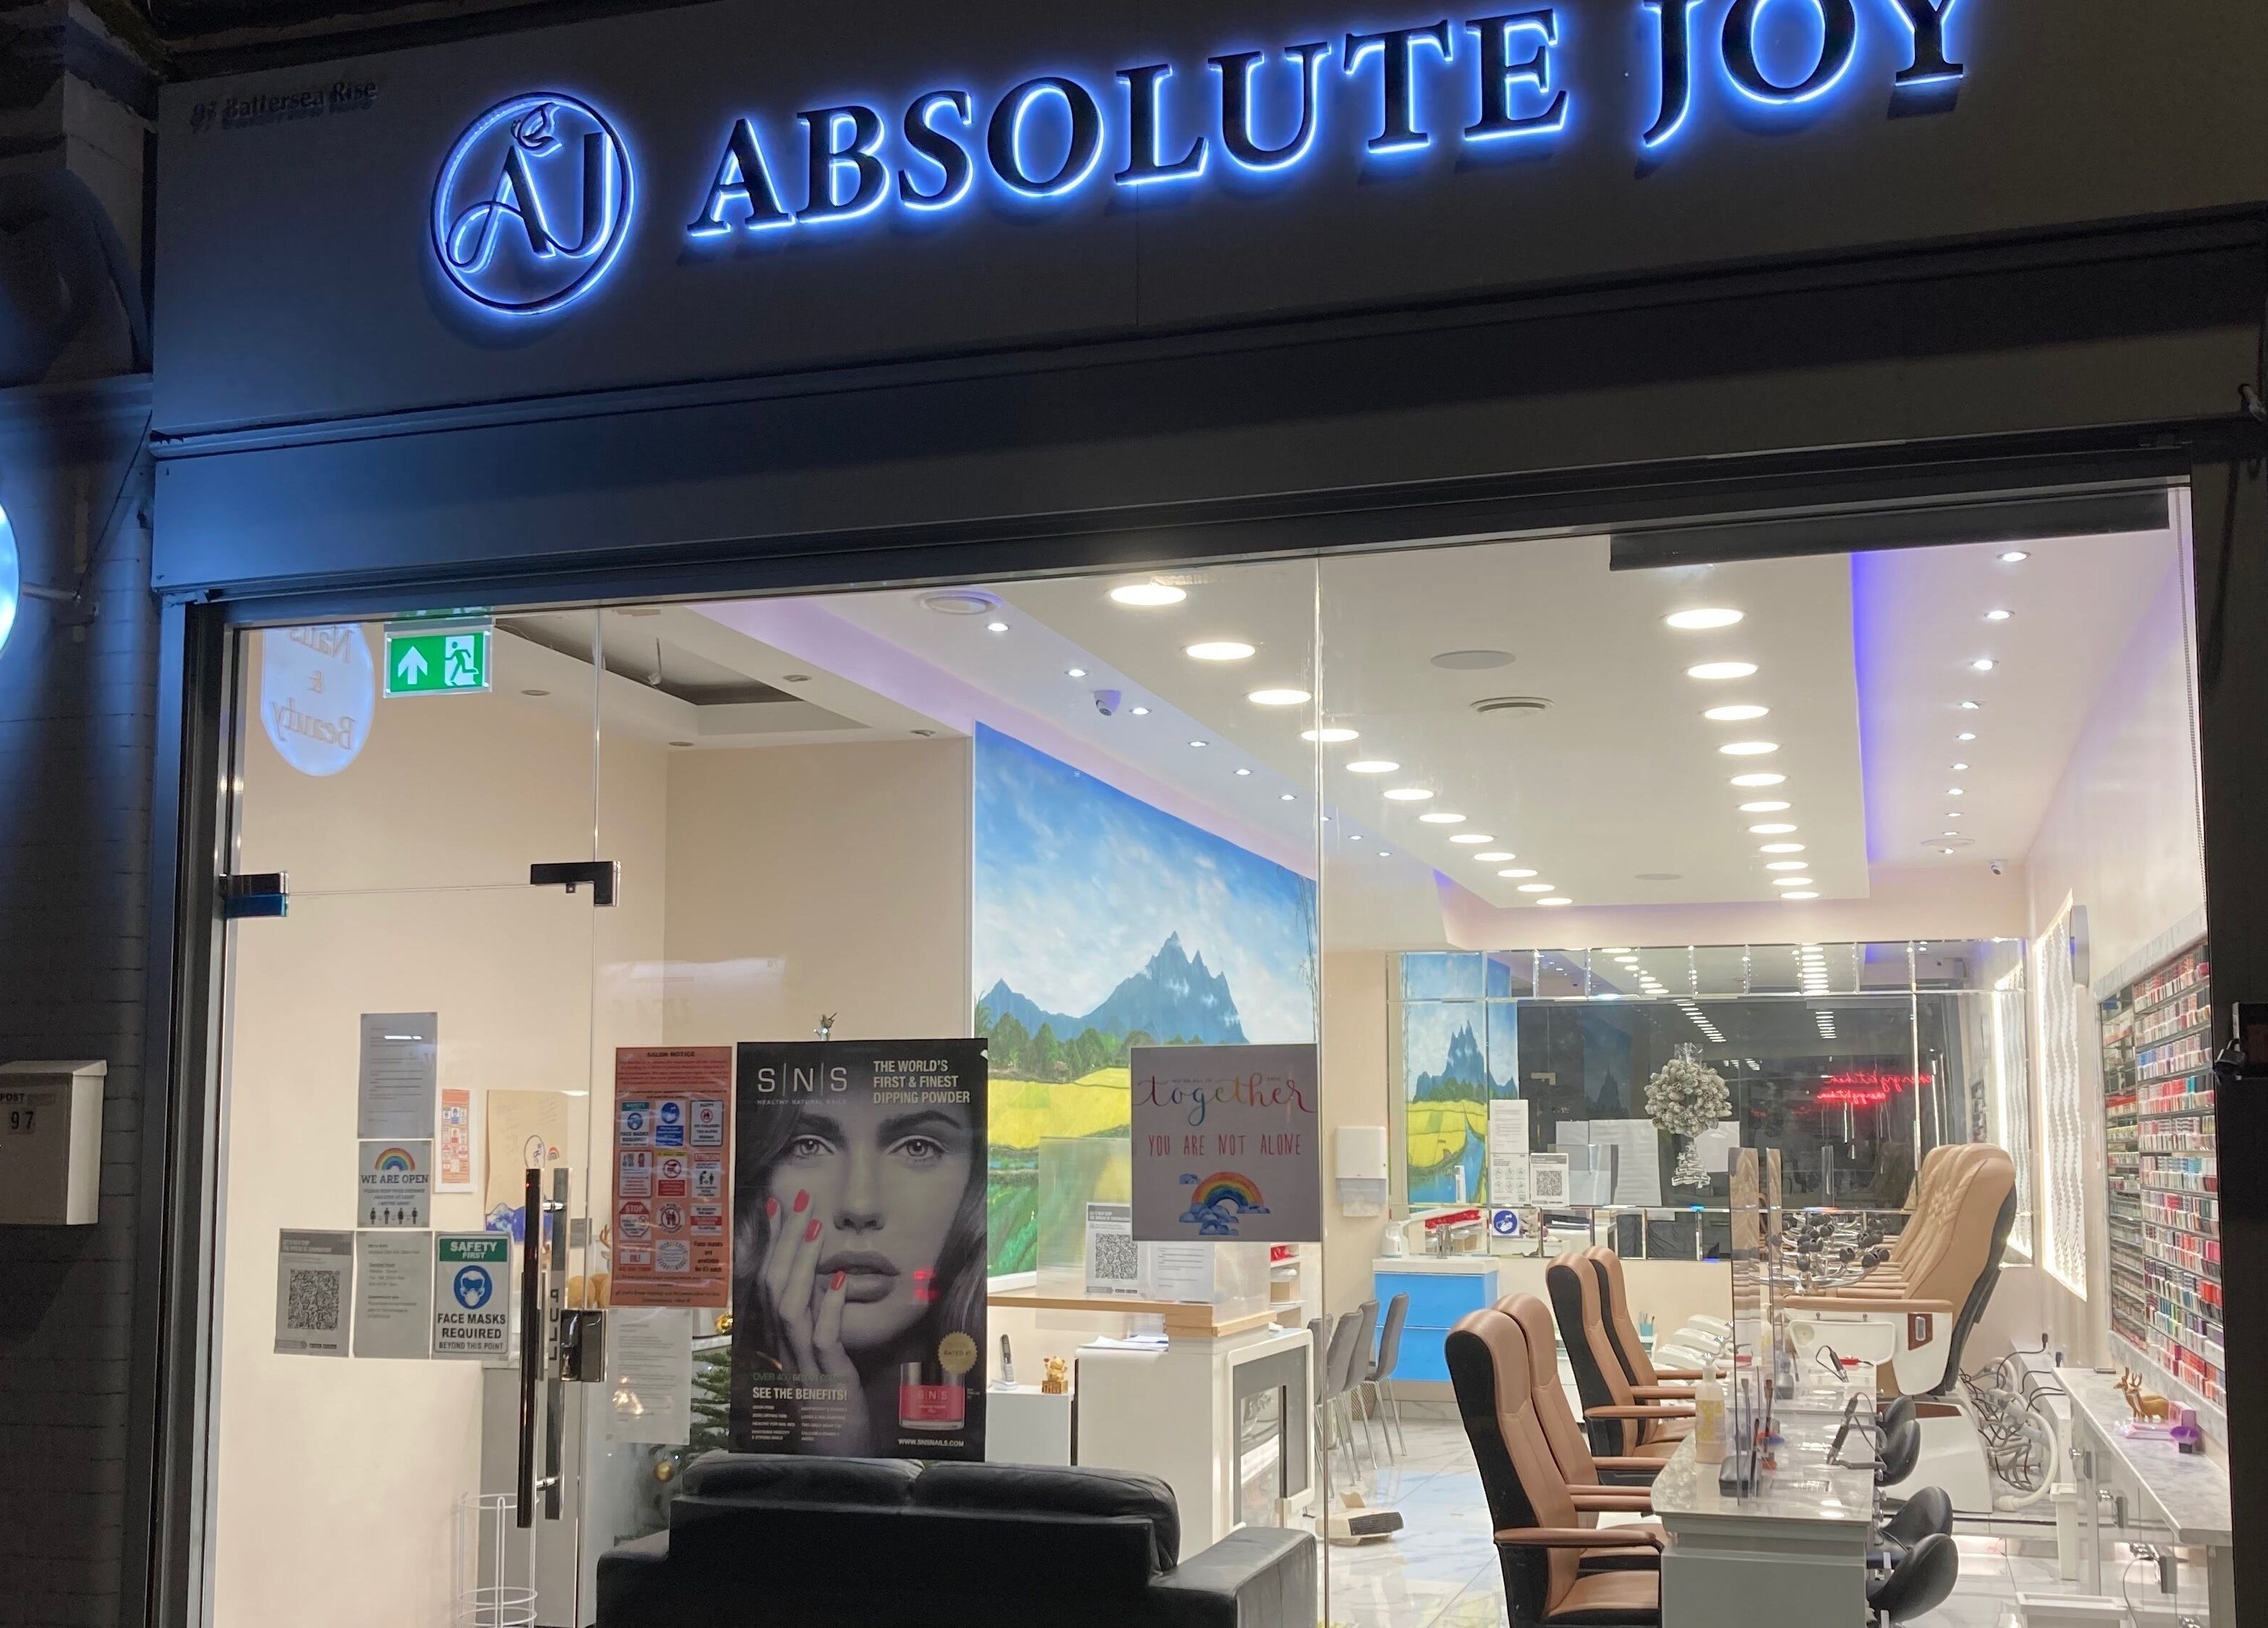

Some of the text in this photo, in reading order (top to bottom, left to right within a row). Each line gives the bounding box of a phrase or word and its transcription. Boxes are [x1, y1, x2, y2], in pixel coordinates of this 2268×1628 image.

[222, 89, 324, 121] Battersea
[330, 79, 379, 106] Rise
[686, 0, 1964, 237] ABSOLUTE JOY
[873, 1059, 949, 1072] THE WORLD'S
[873, 1075, 959, 1088] FIRST & FINEST
[0, 1093, 25, 1103] POST
[873, 1090, 971, 1105] DIPPING POWDER
[1132, 1072, 1318, 1126] together
[10, 1110, 34, 1131] 97
[1148, 1132, 1301, 1156] YOU ARE NOT ALONE
[360, 1174, 429, 1184] WE ARE OPEN
[449, 1241, 497, 1253] SAFETY
[437, 1313, 506, 1324] FACE MASKS
[441, 1328, 502, 1339] REQUIRED
[467, 1342, 482, 1350] THIS
[754, 1372, 776, 1382] OVER
[752, 1386, 848, 1400] SEE THE BENEFITS!
